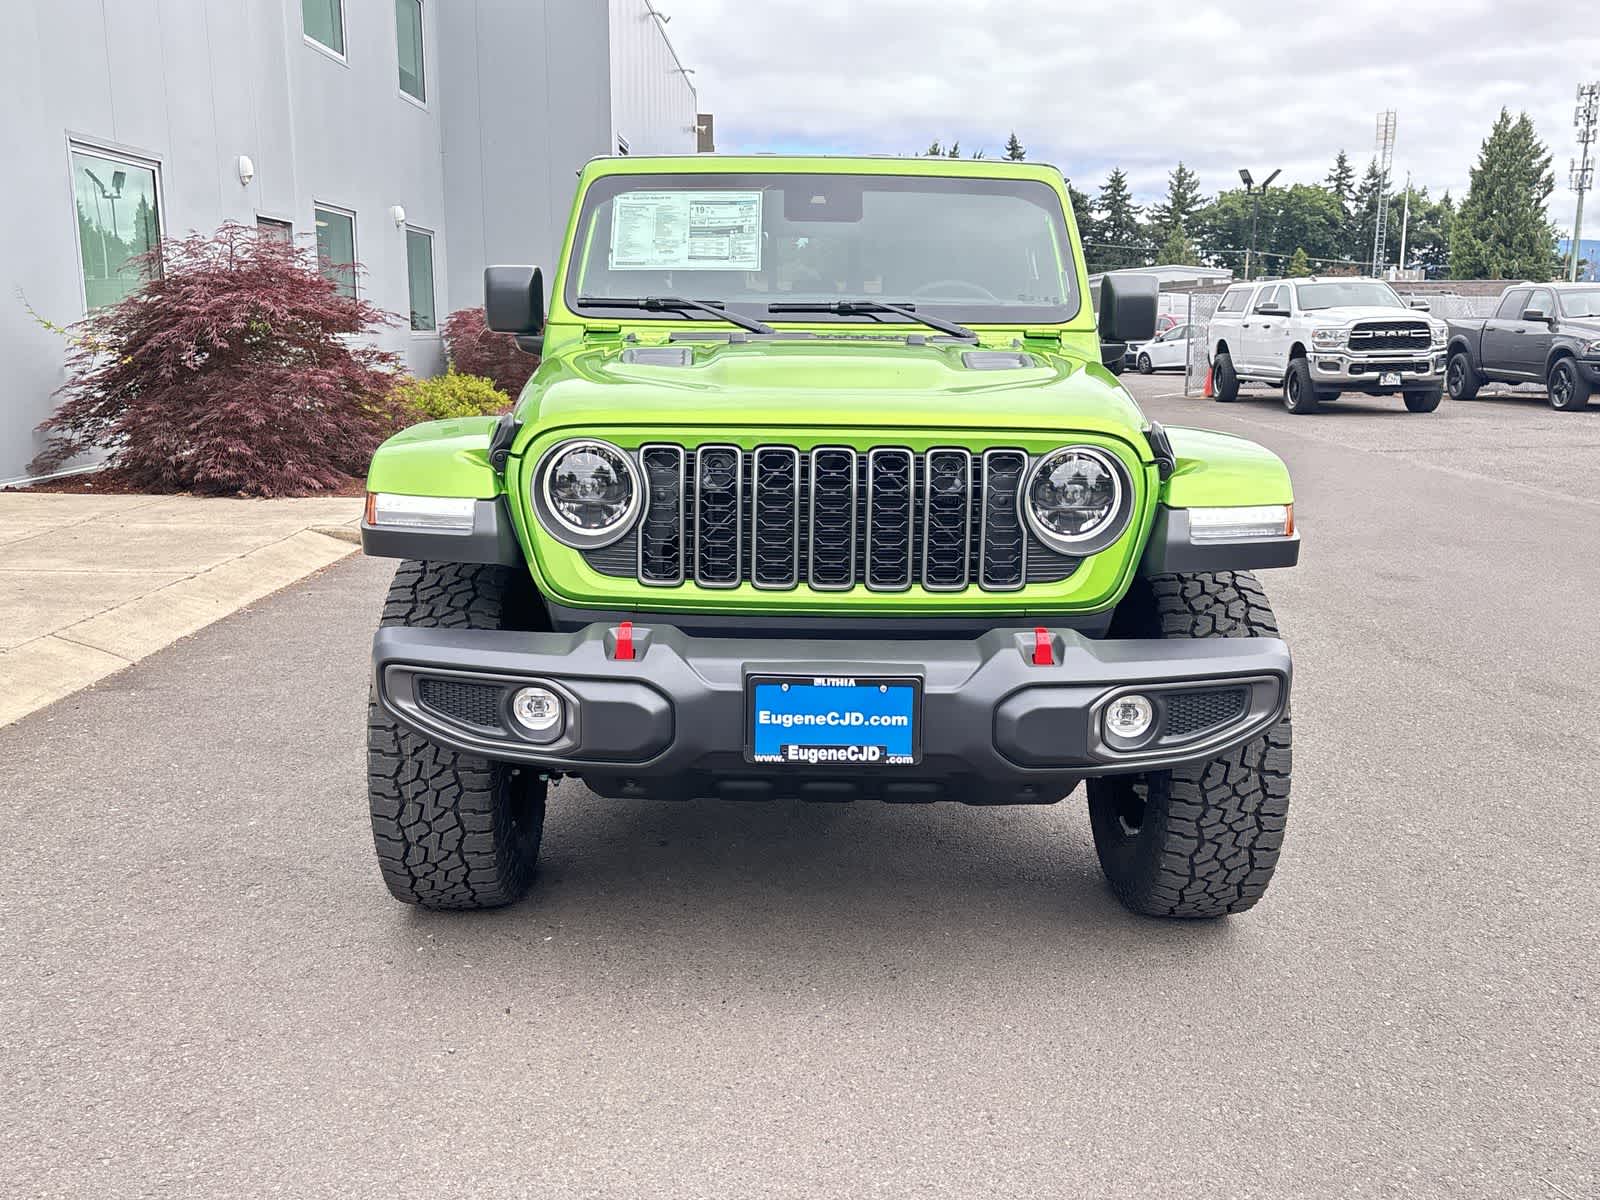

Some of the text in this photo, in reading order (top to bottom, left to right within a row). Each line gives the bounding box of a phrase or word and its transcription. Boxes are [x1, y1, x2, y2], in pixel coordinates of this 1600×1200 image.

[822, 678, 856, 686] LITHIA
[759, 711, 908, 726] EugeneCJD.com
[754, 754, 785, 762] www.
[788, 745, 880, 762] EugeneCJD
